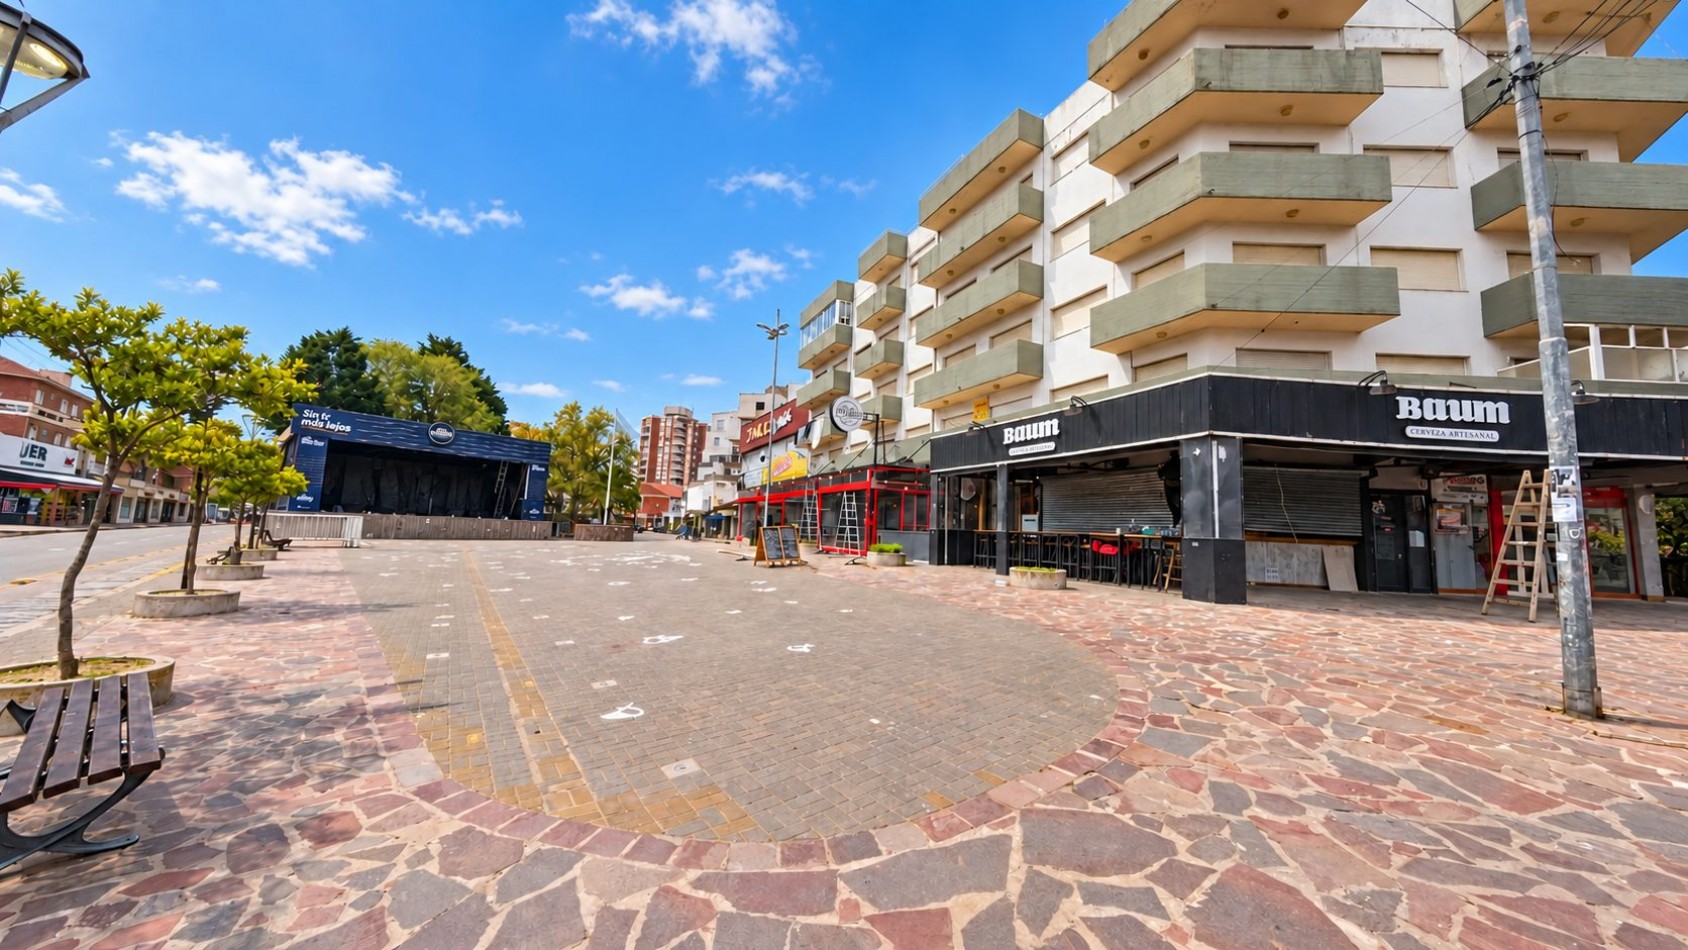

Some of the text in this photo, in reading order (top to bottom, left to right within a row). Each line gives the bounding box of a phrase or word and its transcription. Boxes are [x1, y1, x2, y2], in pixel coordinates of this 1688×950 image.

[1395, 396, 1511, 424] Baum
[1003, 418, 1060, 445] Baum
[1410, 428, 1496, 440] CERVEZA ARTESANAL
